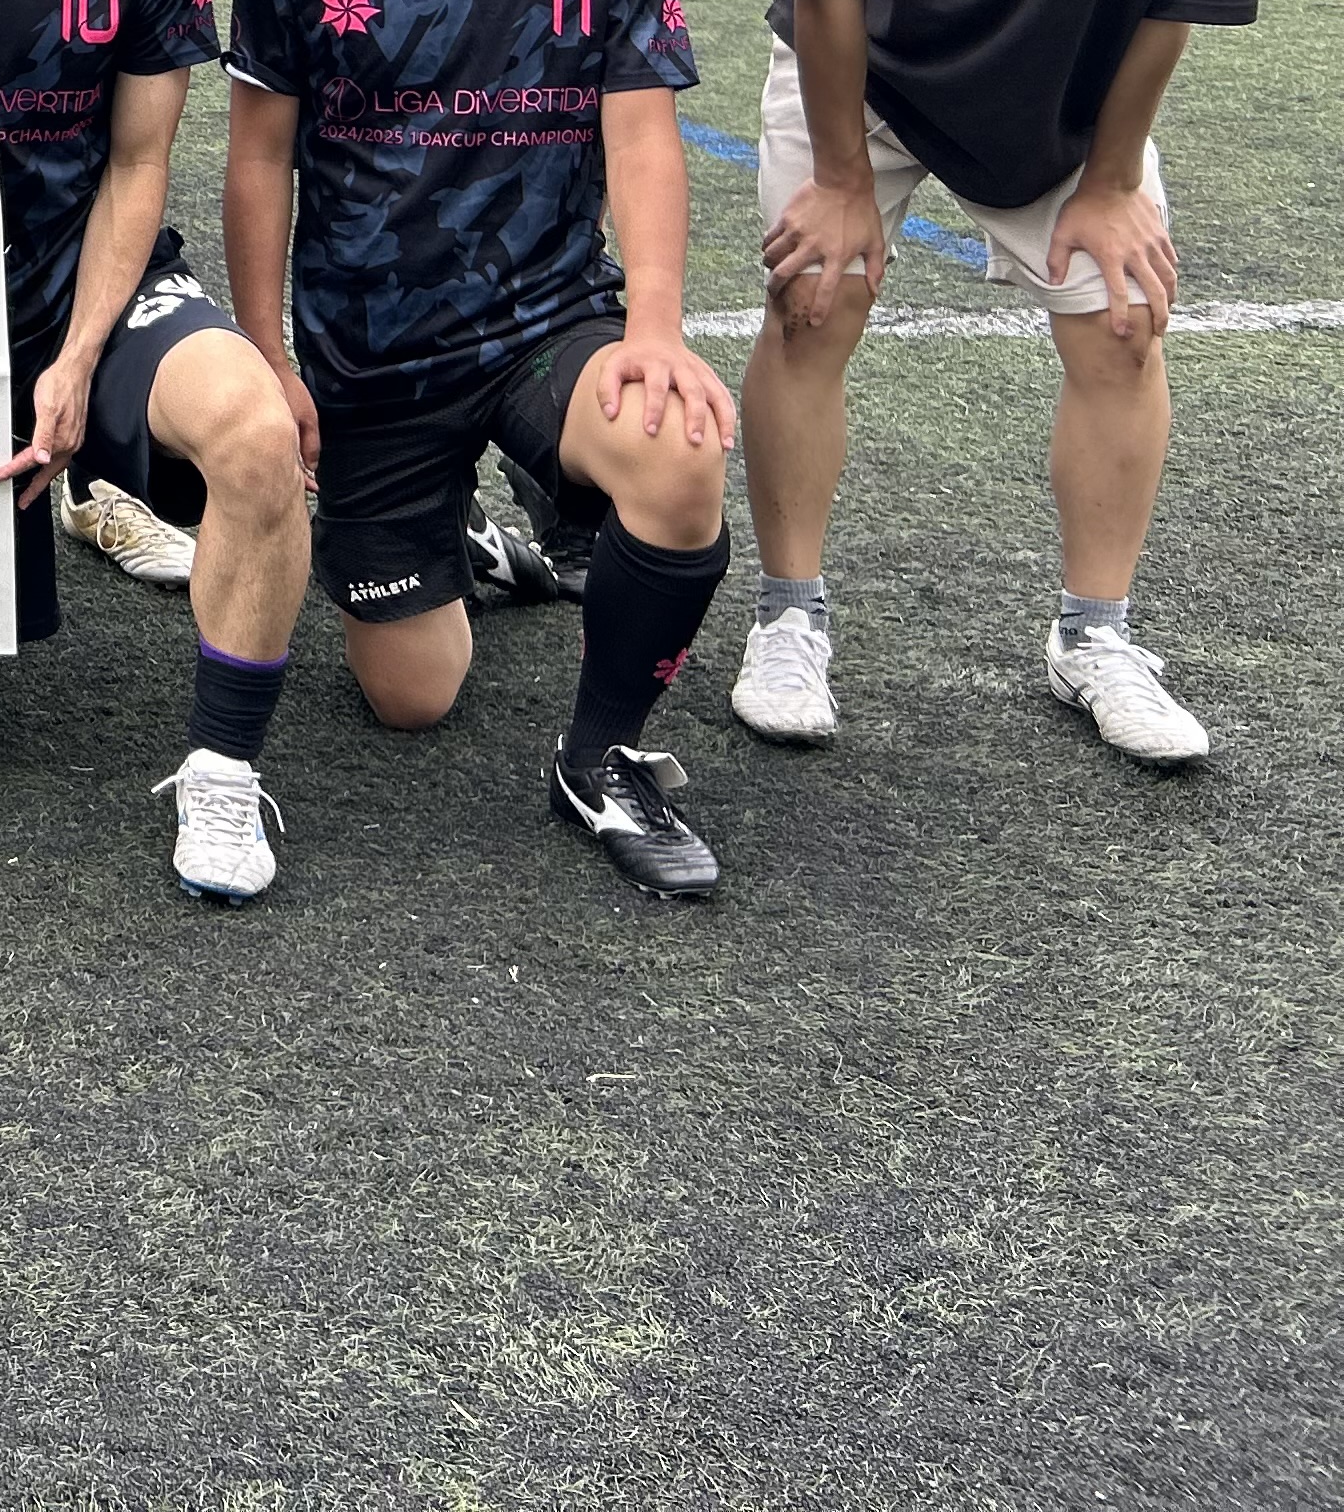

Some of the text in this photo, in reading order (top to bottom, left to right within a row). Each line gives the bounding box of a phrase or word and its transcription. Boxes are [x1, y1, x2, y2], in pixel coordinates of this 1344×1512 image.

[374, 89, 445, 114] LiGA
[318, 124, 595, 148] 2024/2025 1DAYCUP CHAMPIONS
[350, 575, 423, 603] ATHLETA
